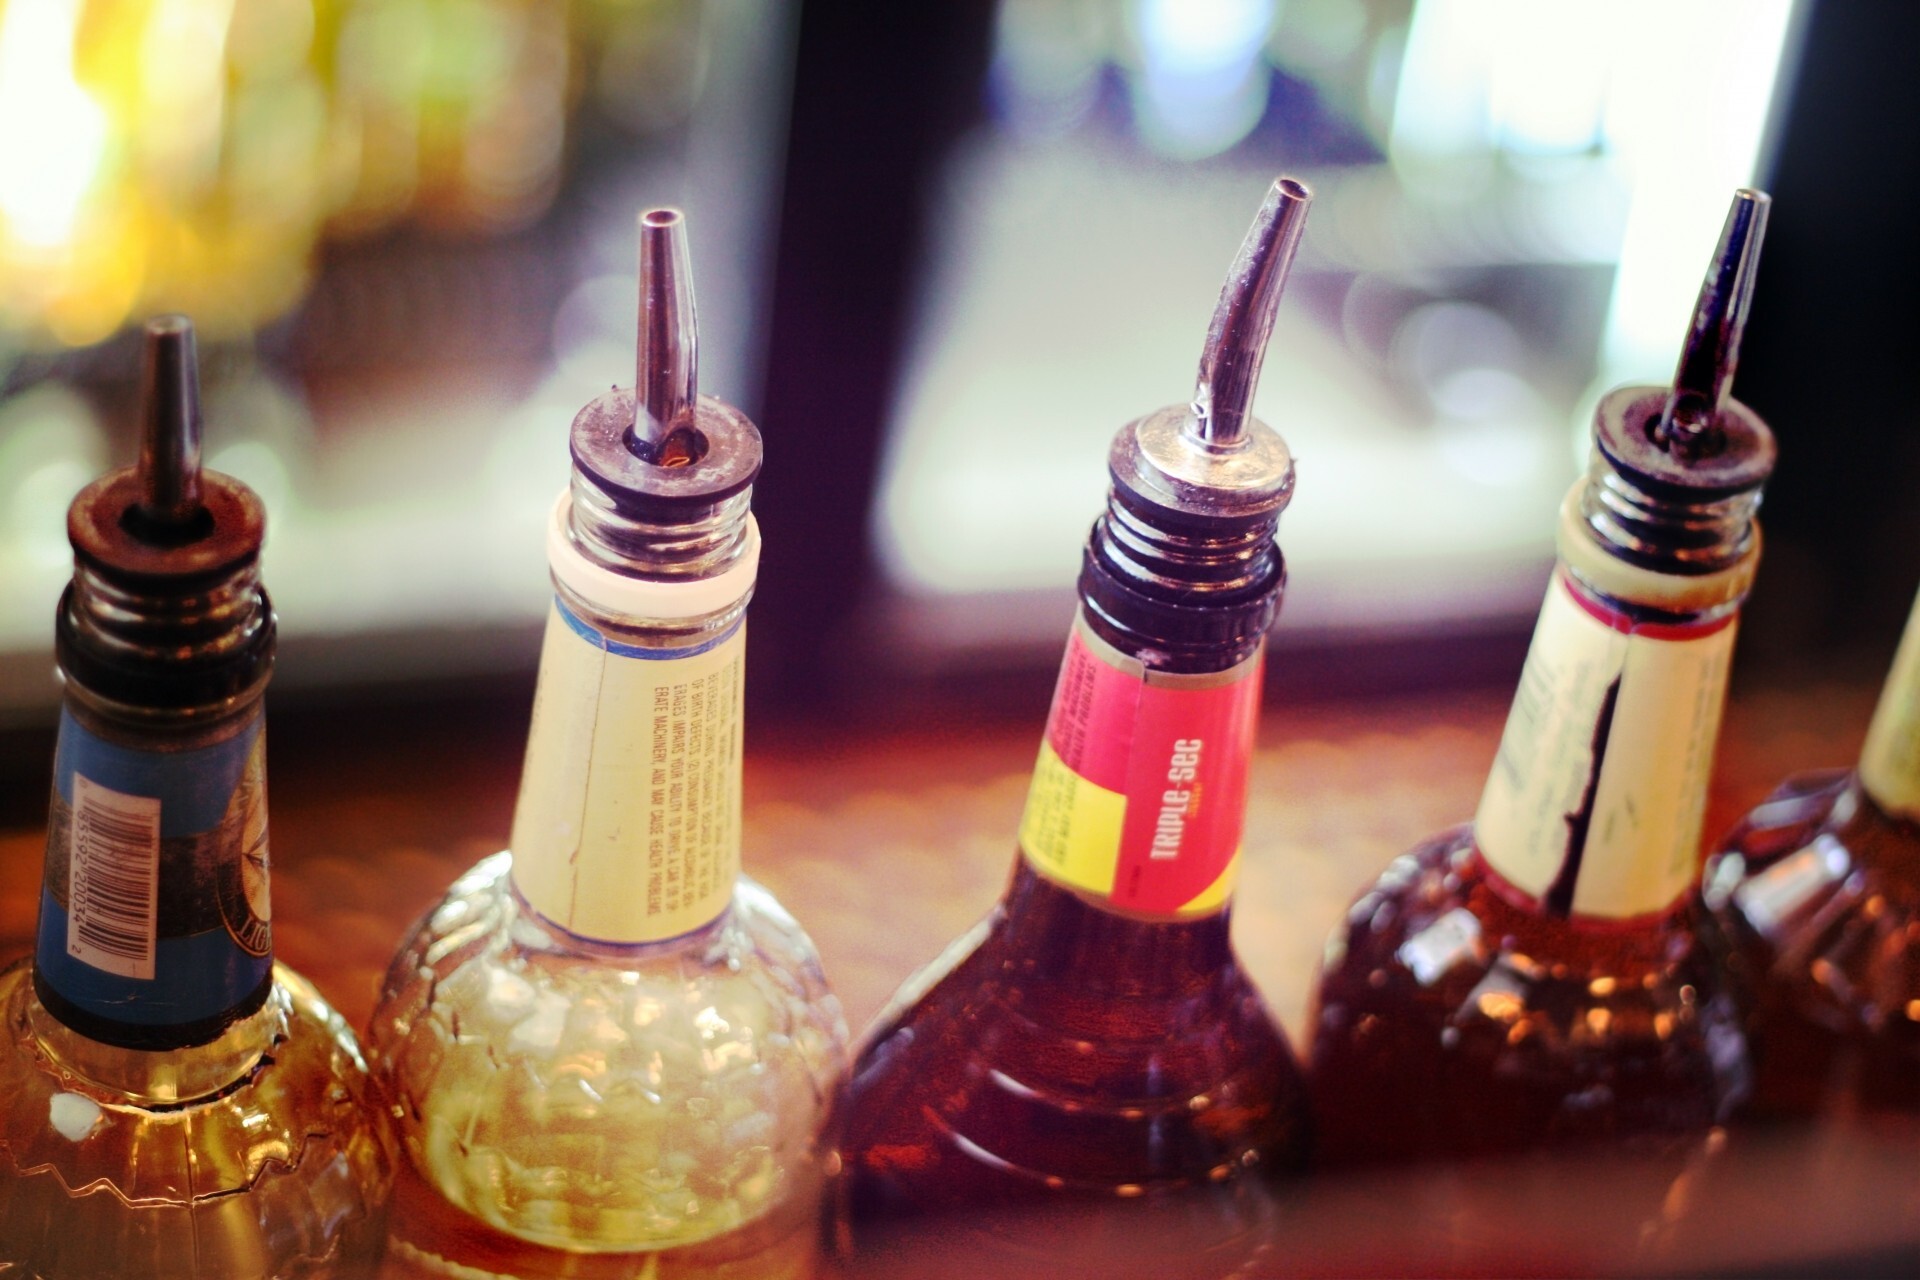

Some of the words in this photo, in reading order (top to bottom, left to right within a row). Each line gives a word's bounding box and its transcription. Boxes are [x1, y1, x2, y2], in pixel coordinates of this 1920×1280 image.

[691, 678, 704, 690] OF
[706, 672, 719, 722] BEVERAGES
[654, 686, 669, 712] ERATE
[673, 684, 687, 717] ERAGES
[691, 691, 703, 718] BIRTH
[651, 715, 668, 765] MACHINERY,
[671, 720, 686, 754] IMPAIRS
[651, 768, 666, 785] AND
[670, 758, 684, 779] YOUR
[651, 788, 665, 805] MAY
[669, 783, 682, 812] ABILITY
[650, 809, 664, 835] CAUSE
[75, 810, 90, 866] 85592
[649, 839, 663, 869] HEALTH
[72, 872, 87, 924] 20034
[71, 944, 83, 955] 2
